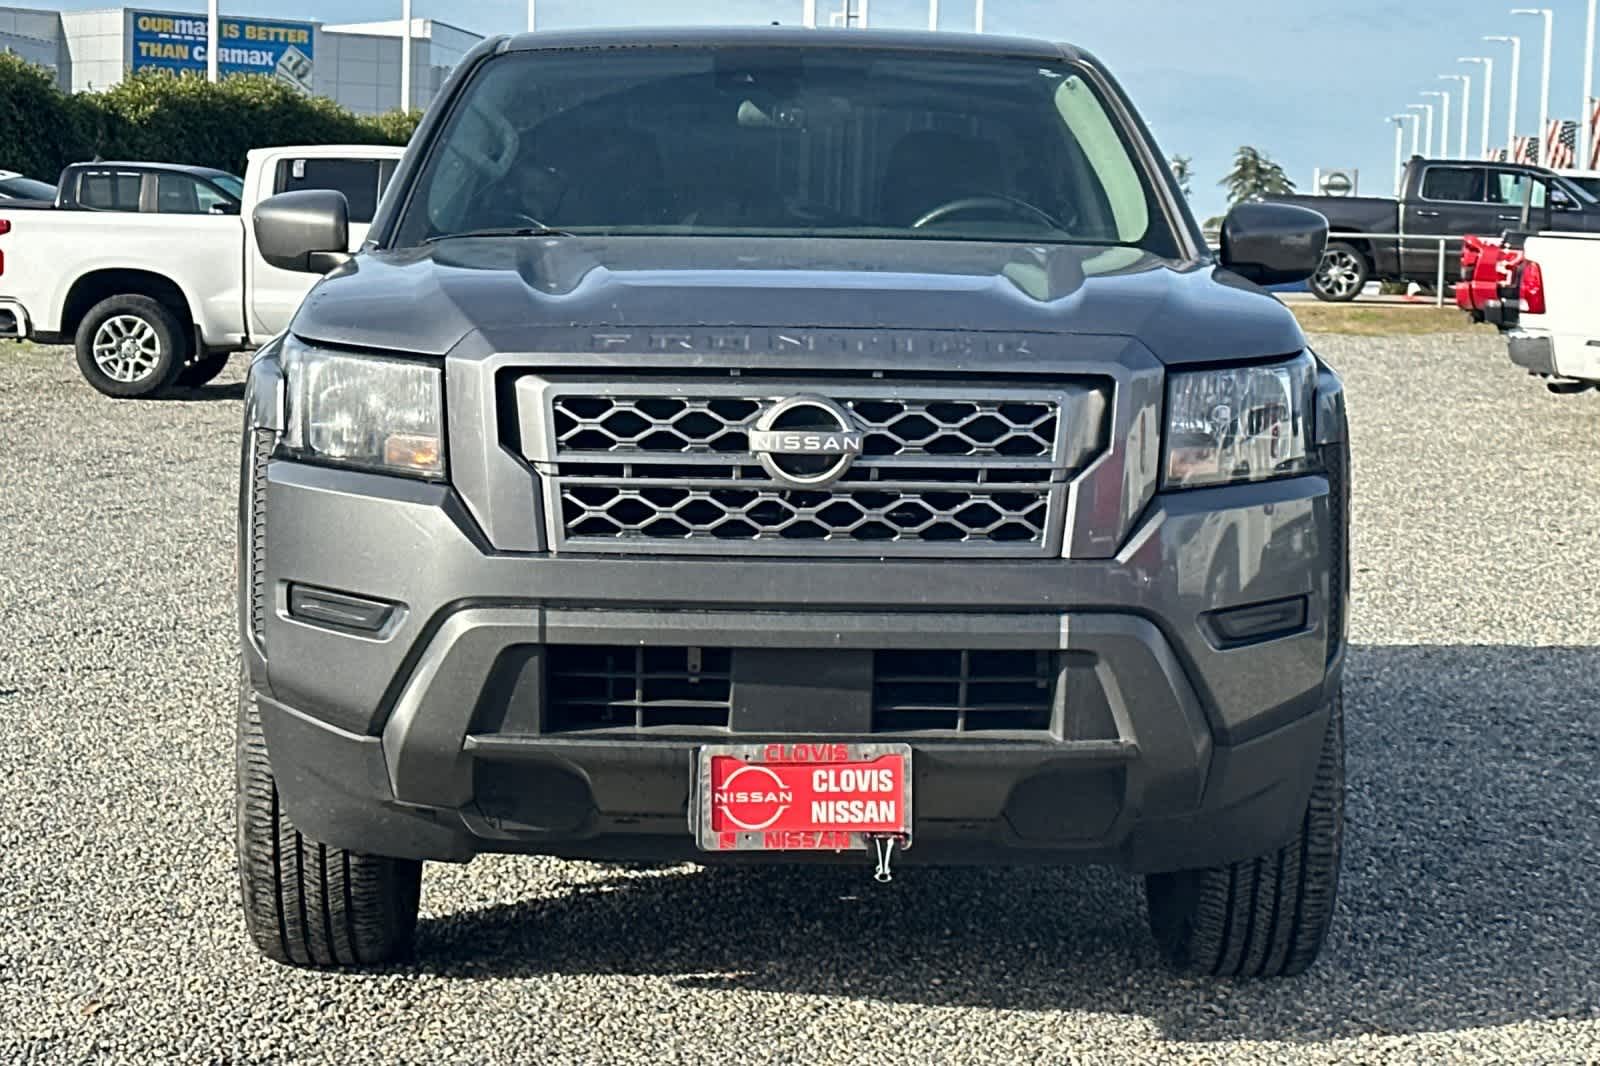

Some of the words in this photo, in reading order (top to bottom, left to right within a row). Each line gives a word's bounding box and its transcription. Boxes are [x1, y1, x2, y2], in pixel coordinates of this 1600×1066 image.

[138, 16, 208, 36] OURma
[222, 23, 240, 39] IS
[245, 24, 309, 44] BETTER
[138, 42, 189, 59] THAN
[756, 435, 860, 451] NISSAN
[764, 744, 849, 762] CLOVIS
[812, 769, 893, 793] CLOVIS
[714, 791, 793, 804] NISSAN
[811, 800, 896, 824] NISSAN
[764, 832, 849, 849] NISSAN
